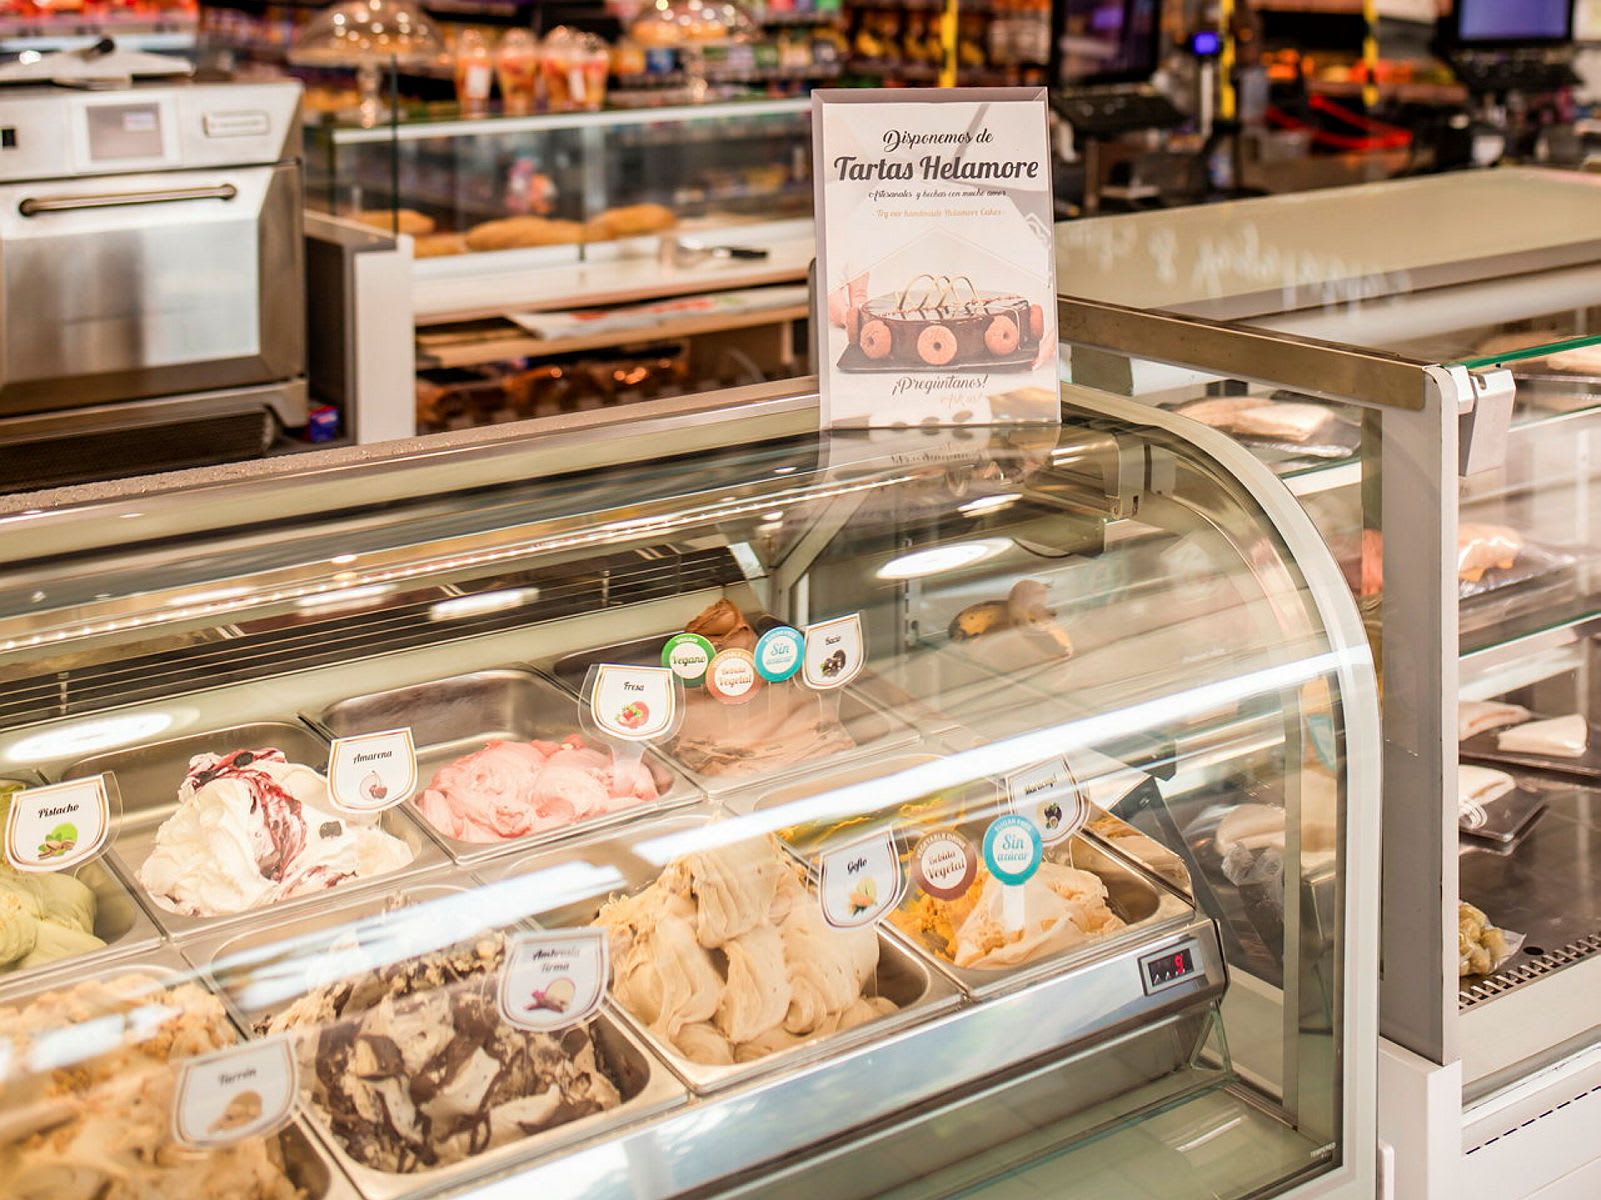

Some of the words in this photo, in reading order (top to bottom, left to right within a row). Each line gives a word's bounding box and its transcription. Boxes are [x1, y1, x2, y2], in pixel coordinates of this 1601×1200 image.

[883, 129, 972, 153] Disponemos
[975, 127, 994, 144] de
[833, 155, 914, 181] Tartas
[919, 155, 1039, 181] Helamore
[770, 643, 790, 656] Sin
[623, 681, 645, 691] Fresa
[353, 751, 393, 765] Amarena
[38, 803, 80, 819] Pistacho
[1002, 834, 1024, 850] Sin
[926, 860, 965, 879] Vegetal
